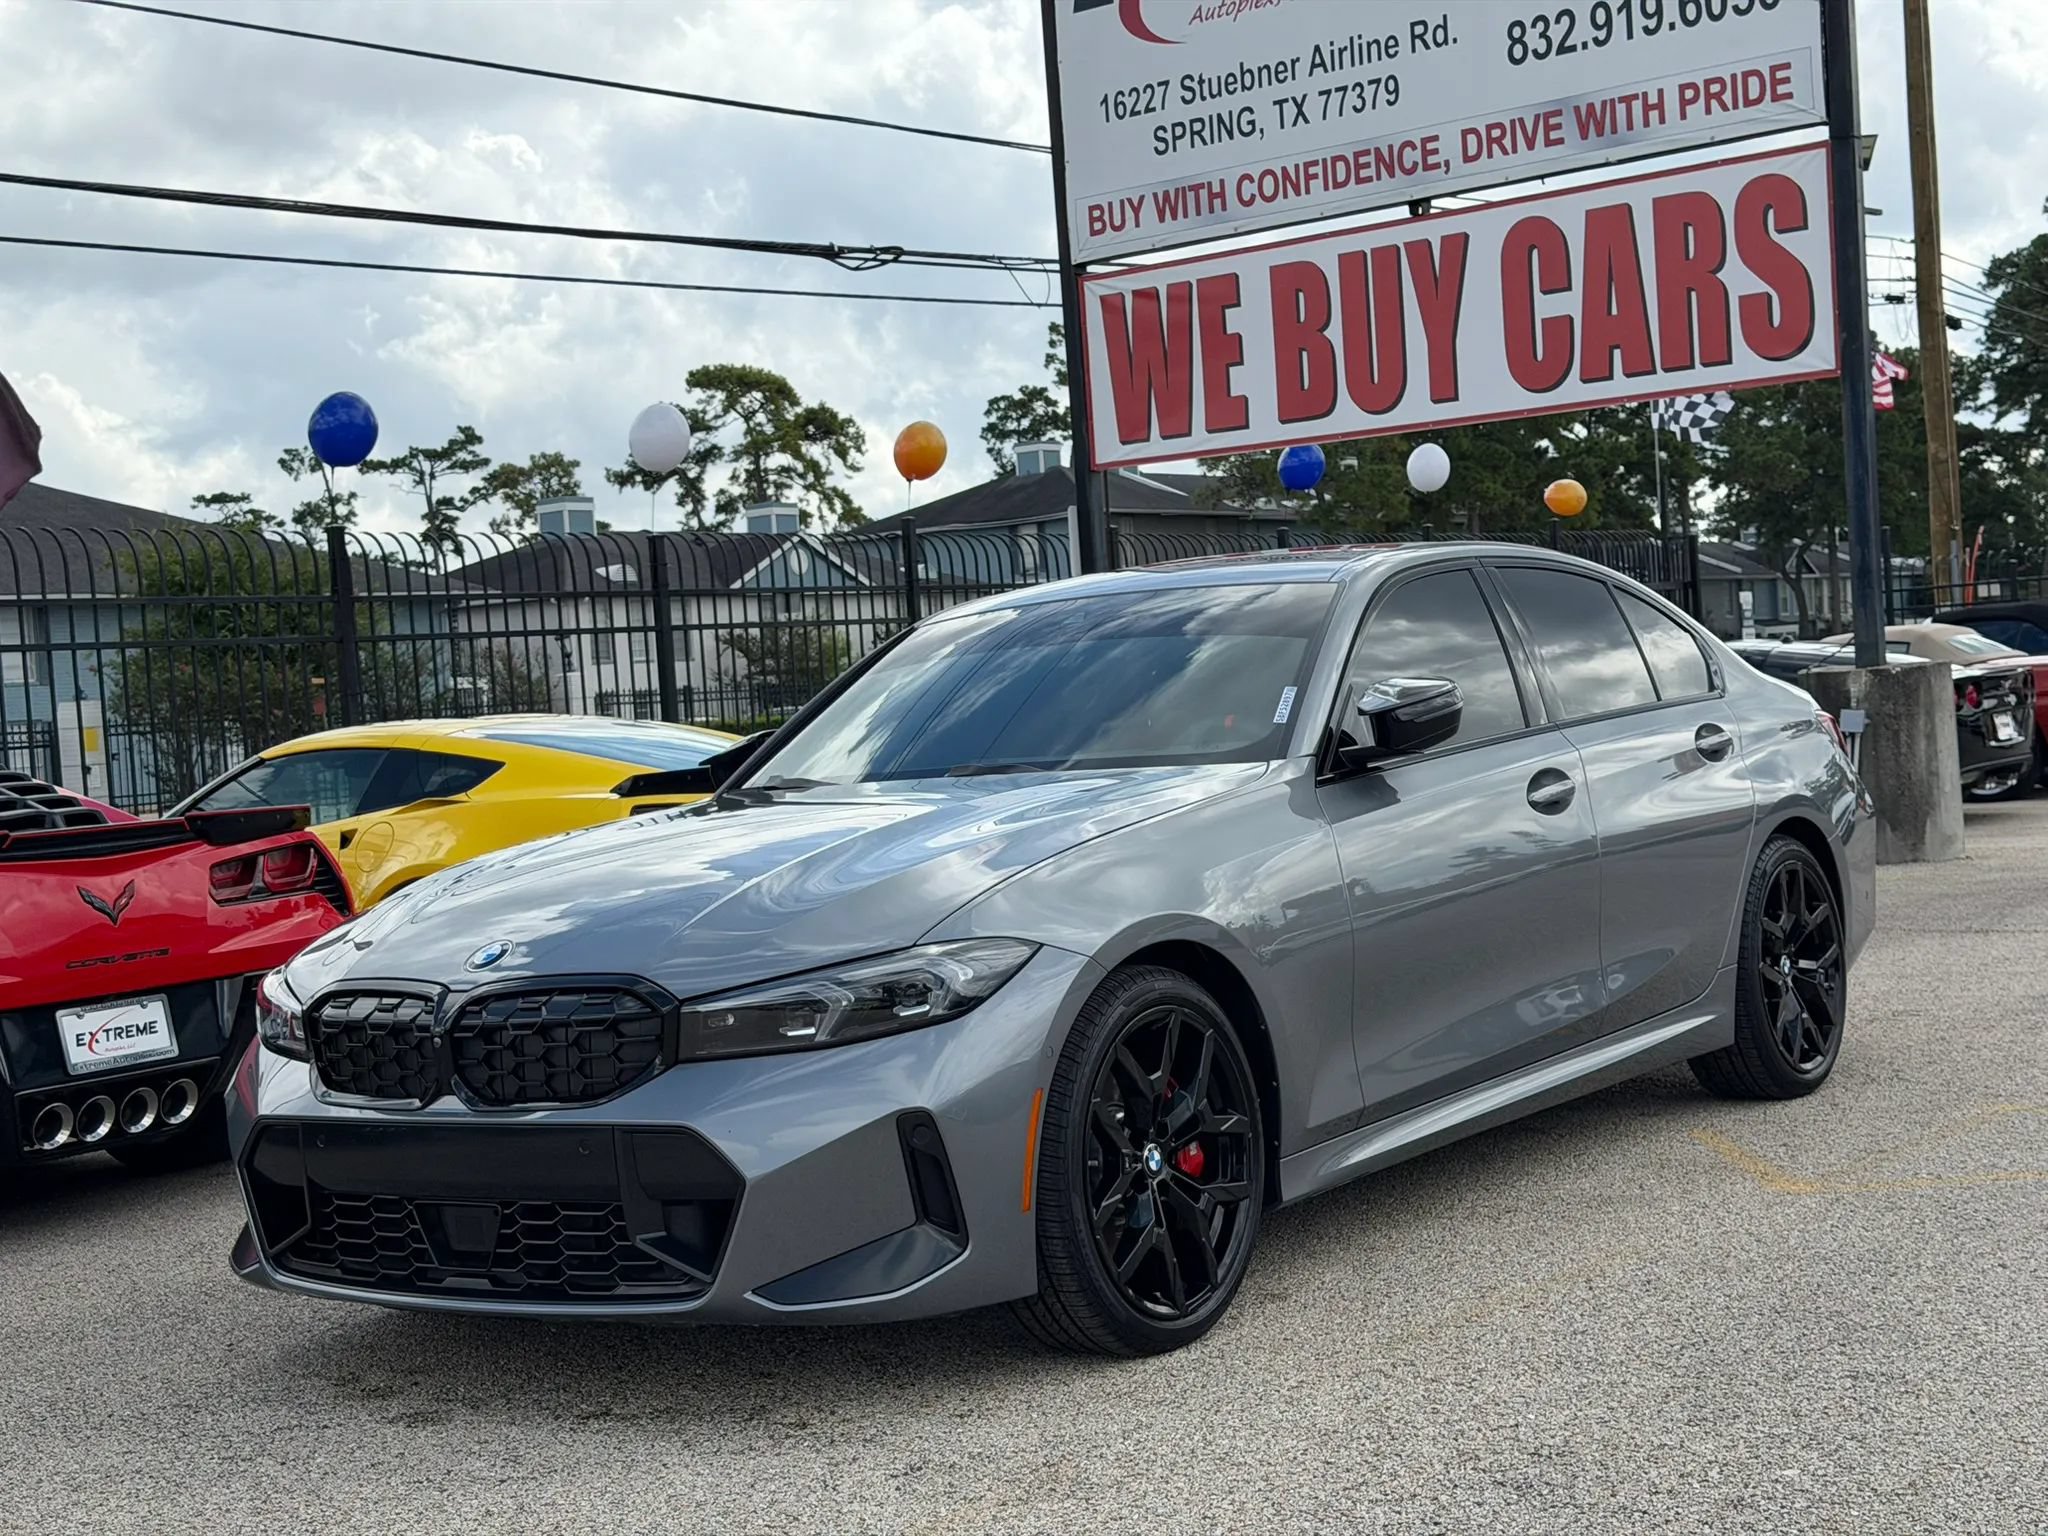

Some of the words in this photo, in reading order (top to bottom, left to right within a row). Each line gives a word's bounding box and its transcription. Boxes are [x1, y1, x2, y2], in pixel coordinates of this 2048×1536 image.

[1099, 80, 1170, 123] 16227
[1180, 57, 1301, 104] Stuebner
[1309, 30, 1400, 77] Airline
[1409, 14, 1458, 54] Rd.
[1153, 106, 1265, 156] SPRING,
[1272, 95, 1311, 131] TX
[1317, 74, 1400, 122] 77379
[1088, 194, 1146, 238] BUY
[1152, 177, 1228, 222] WITH
[1235, 134, 1451, 208] CONFIDENCE,
[1460, 109, 1565, 164] DRIVE
[1573, 88, 1665, 142] WITH
[1678, 62, 1794, 121] PRIDE
[1099, 271, 1250, 446] WE
[1268, 231, 1471, 424] BUY
[1500, 172, 1816, 394] CARS
[75, 1020, 159, 1047] EXTREME
